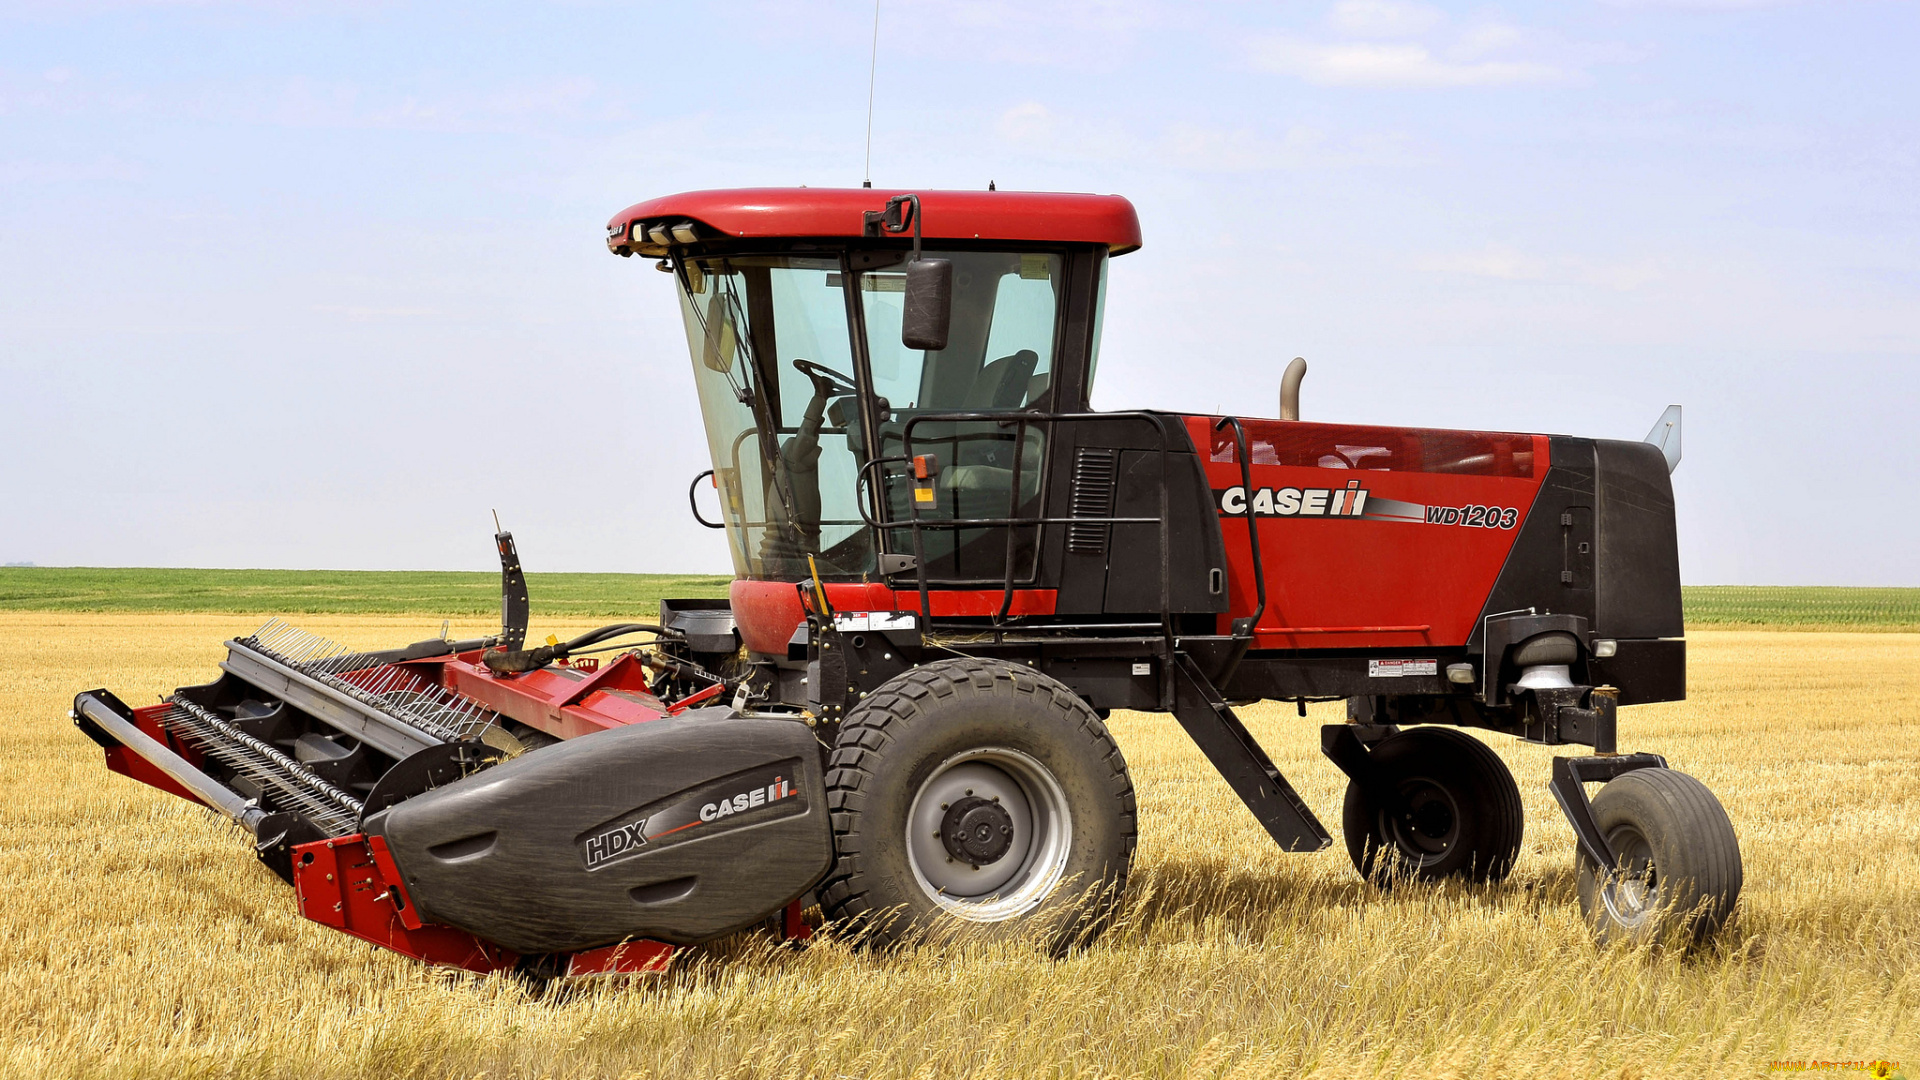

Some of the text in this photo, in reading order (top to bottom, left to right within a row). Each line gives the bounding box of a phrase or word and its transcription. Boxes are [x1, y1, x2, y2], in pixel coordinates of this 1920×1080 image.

[1425, 504, 1519, 530] WD1203
[699, 787, 765, 823] CASE
[586, 819, 647, 865] HDX
